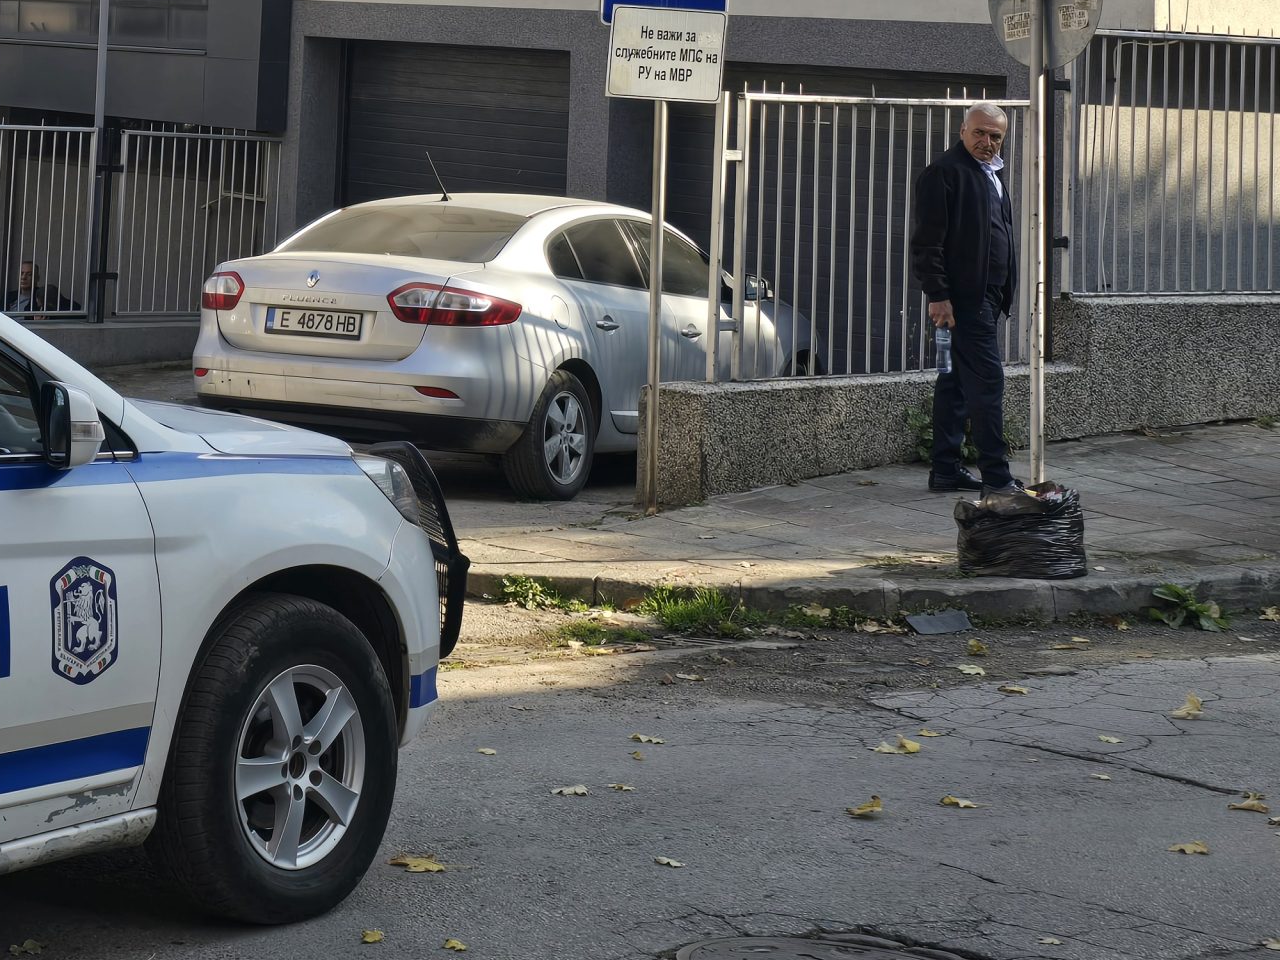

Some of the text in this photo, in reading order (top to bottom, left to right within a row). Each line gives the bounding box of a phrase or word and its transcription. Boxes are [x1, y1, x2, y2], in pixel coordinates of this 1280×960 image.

[640, 25, 696, 42] Не важи за
[615, 46, 718, 64] служебните МПС на
[638, 66, 693, 82] РУ на МВР
[280, 311, 291, 328] E
[297, 312, 333, 331] 4878
